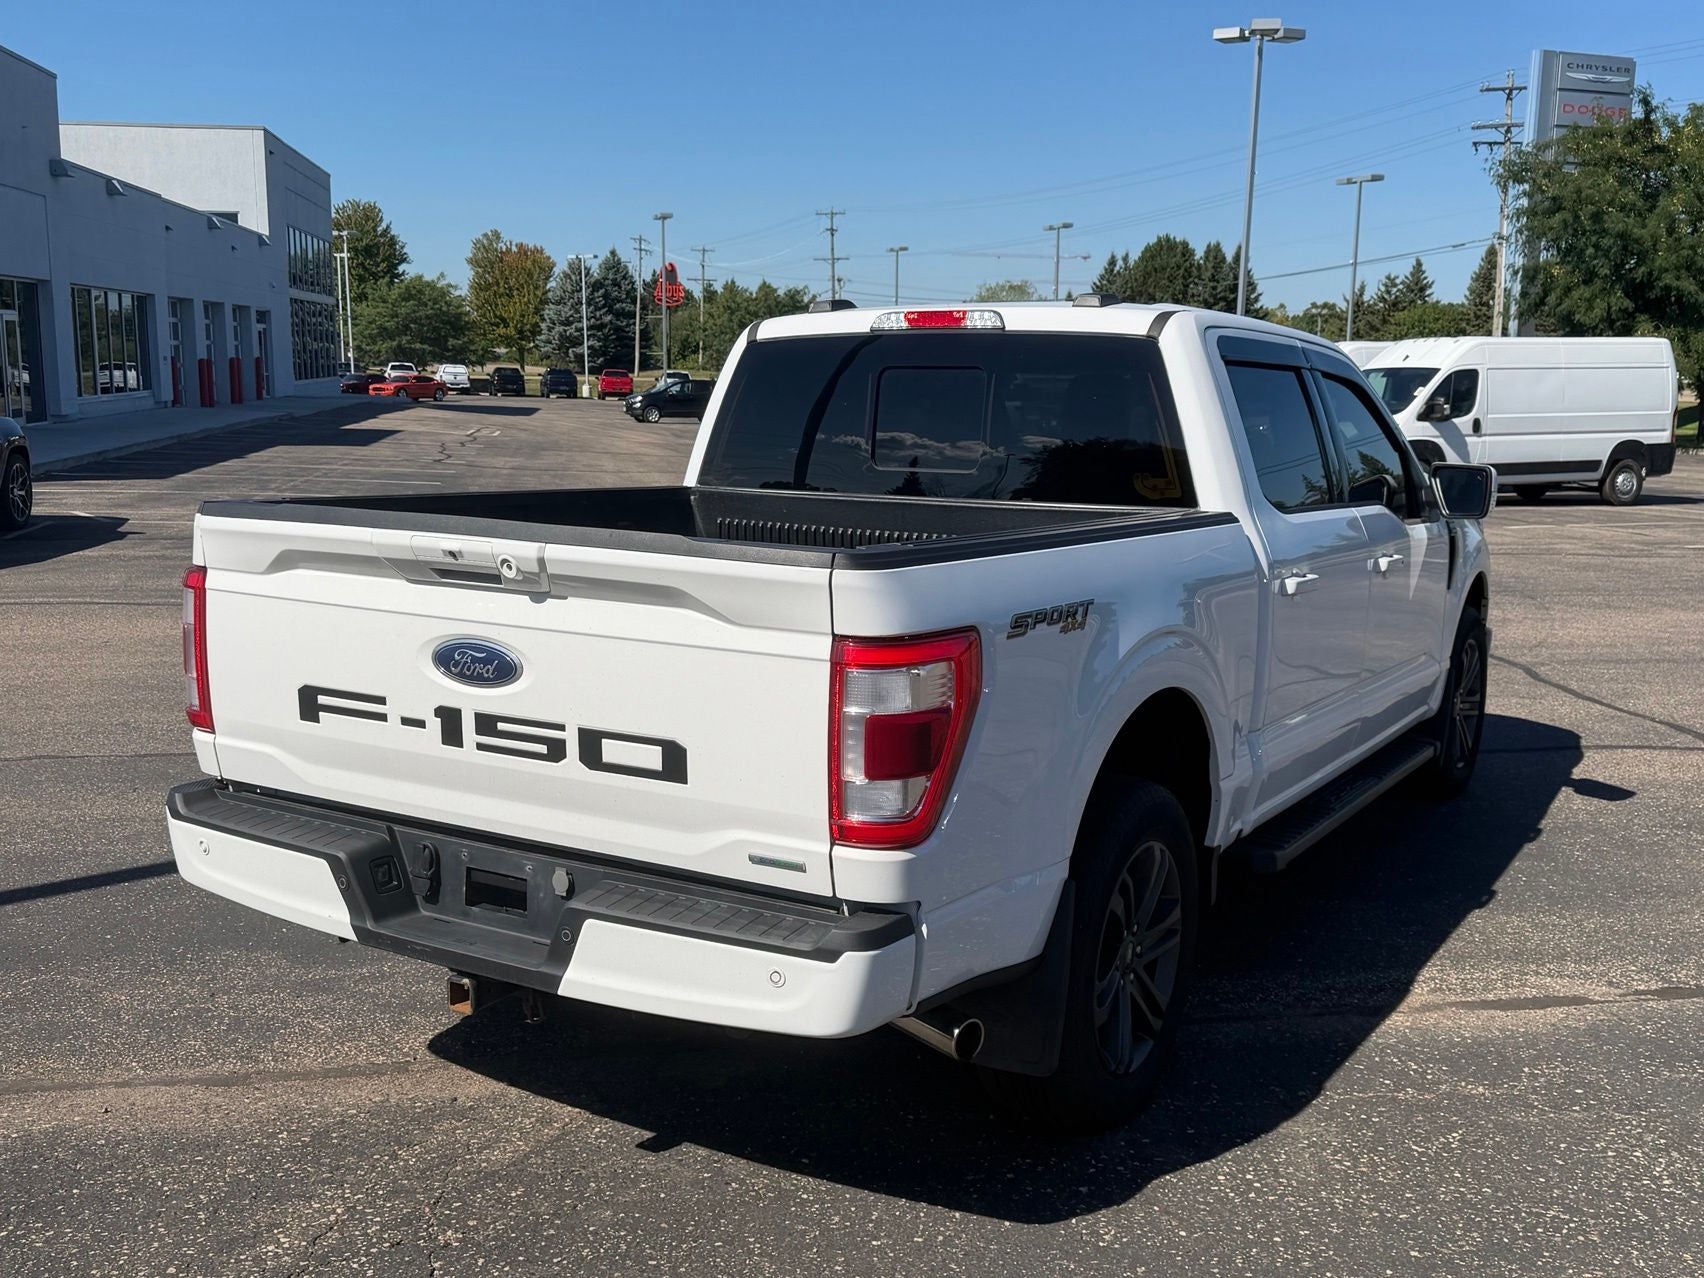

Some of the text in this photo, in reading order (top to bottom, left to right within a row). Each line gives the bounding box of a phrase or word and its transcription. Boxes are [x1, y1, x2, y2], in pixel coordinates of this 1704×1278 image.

[1566, 62, 1631, 74] CHRYSLER
[653, 281, 685, 300] Aby's
[1006, 598, 1095, 640] SPORT
[449, 648, 499, 679] Ford
[297, 684, 689, 785] F-150
